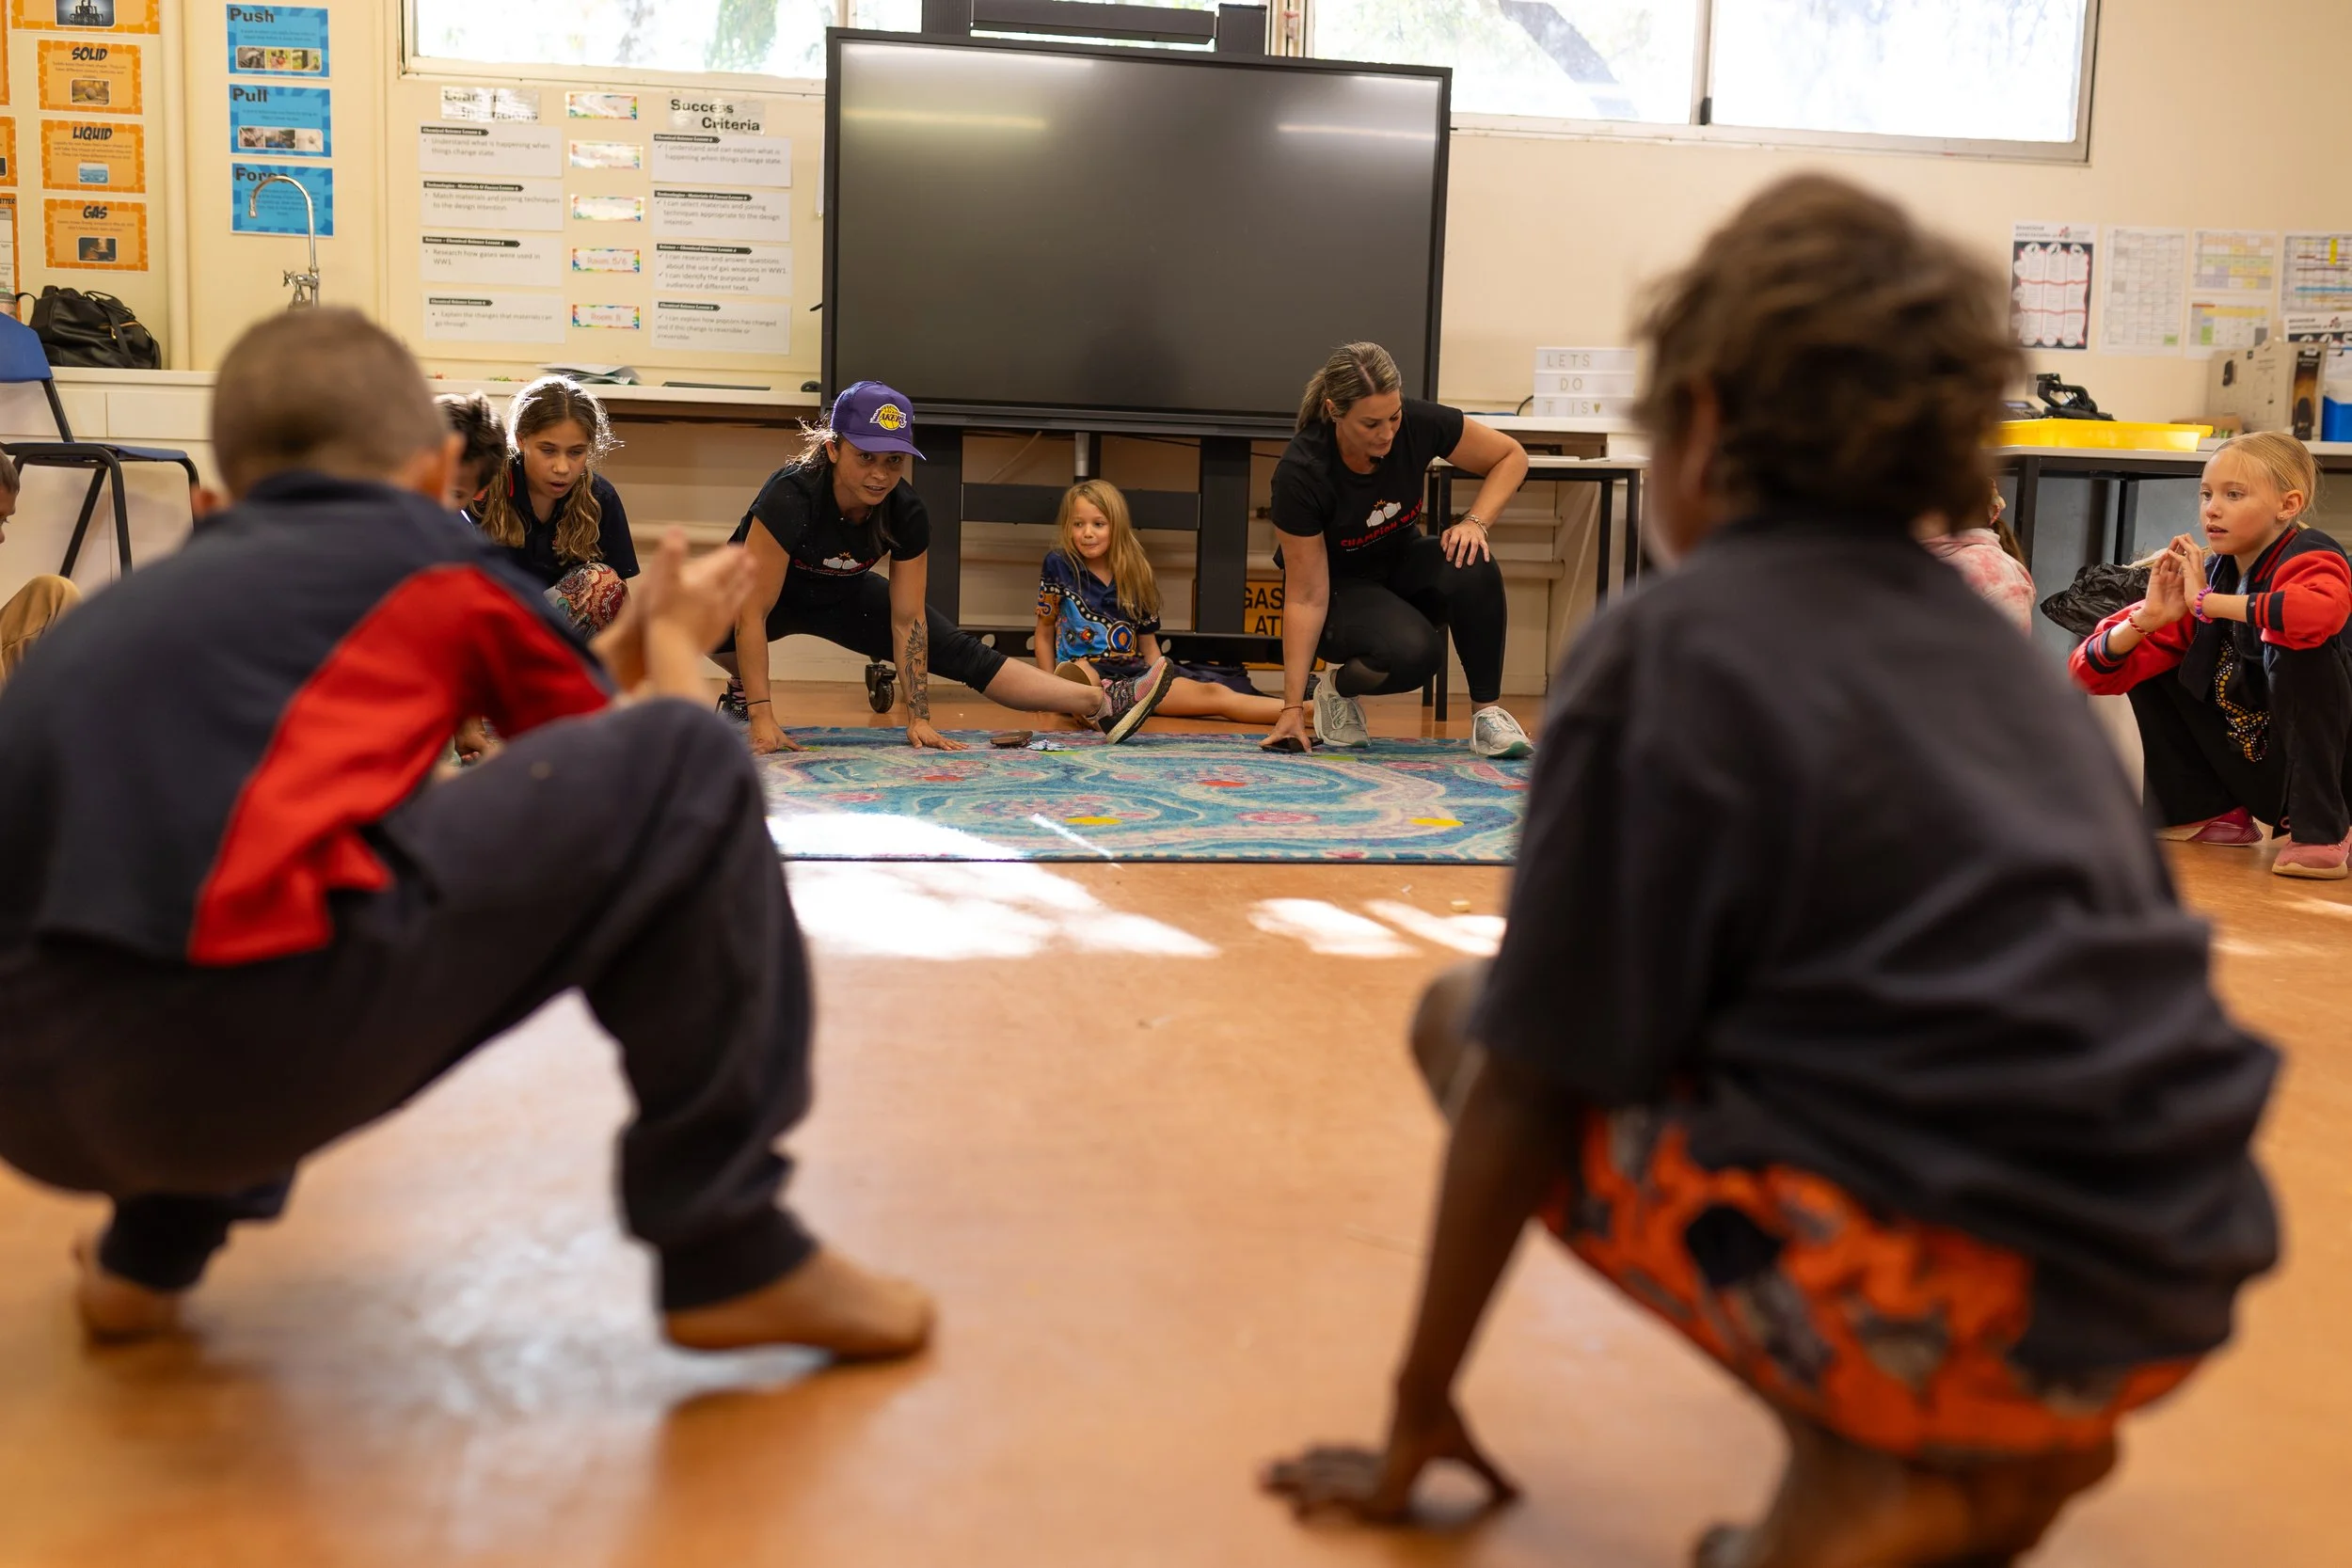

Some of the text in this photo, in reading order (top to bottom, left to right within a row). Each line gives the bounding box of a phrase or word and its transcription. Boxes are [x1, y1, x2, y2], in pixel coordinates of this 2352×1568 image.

[230, 8, 274, 23] Push
[72, 46, 107, 61] SOLID
[232, 87, 267, 103] Pull
[702, 117, 760, 131] Criteria
[72, 126, 113, 141] LIQUID
[431, 137, 469, 146] Understand
[496, 140, 531, 150] happening
[432, 147, 452, 156] things
[453, 148, 476, 157] change
[733, 146, 755, 155] explain
[666, 152, 699, 163] happening
[720, 154, 739, 164] things
[740, 155, 763, 165] change
[453, 201, 475, 211] design
[501, 194, 522, 203] joining
[524, 195, 560, 205] techniques
[744, 201, 766, 211] joining
[83, 205, 107, 219] GAS
[664, 209, 698, 218] techniques
[700, 210, 737, 220] appropriate
[758, 212, 780, 221] design
[434, 248, 462, 257] Research
[682, 253, 709, 261] research
[681, 272, 706, 281] identify
[720, 275, 745, 283] purpose
[666, 280, 694, 289] audience
[513, 311, 540, 320] materials
[680, 314, 700, 324] explain
[752, 318, 776, 327] changed
[686, 324, 707, 333] change
[1548, 354, 1590, 367] LETS
[1560, 377, 1582, 391] DO
[870, 409, 907, 427] LAKERS
[1244, 587, 1282, 610] GAS
